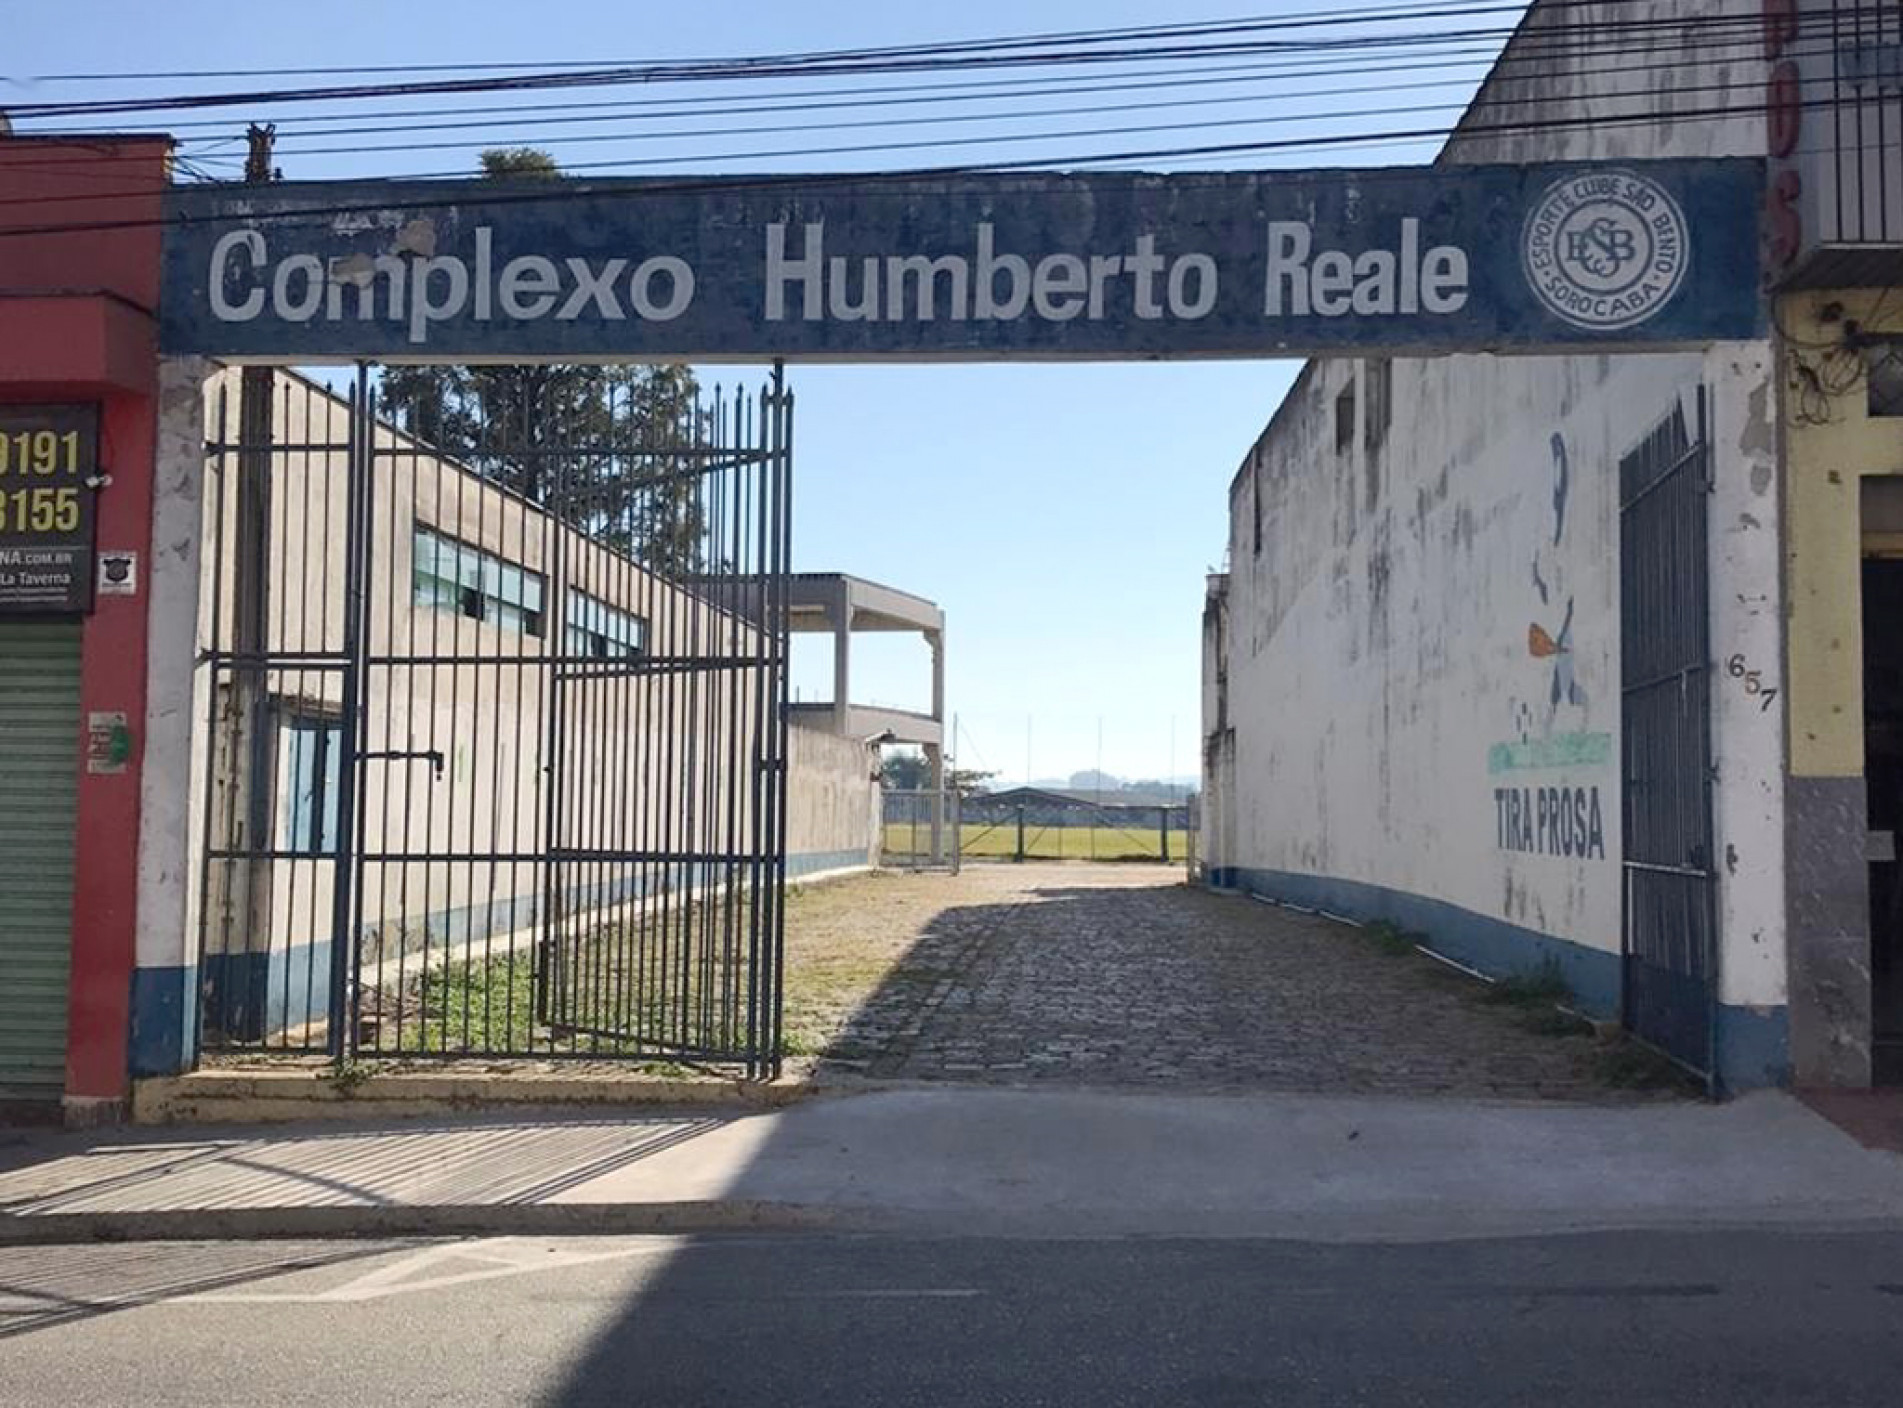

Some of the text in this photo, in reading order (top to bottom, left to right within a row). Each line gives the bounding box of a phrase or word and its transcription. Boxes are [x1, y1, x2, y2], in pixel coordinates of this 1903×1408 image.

[1532, 190, 1575, 270] ESPORTE
[1573, 178, 1622, 200] CLUBE
[1653, 212, 1677, 274] BENTO
[209, 217, 1469, 343] Complexo Humberto Reale
[1545, 276, 1660, 317] SOROCABA
[0, 488, 79, 532] 155
[1728, 653, 1777, 712] 657
[1494, 785, 1605, 860] TIRA PROSA
